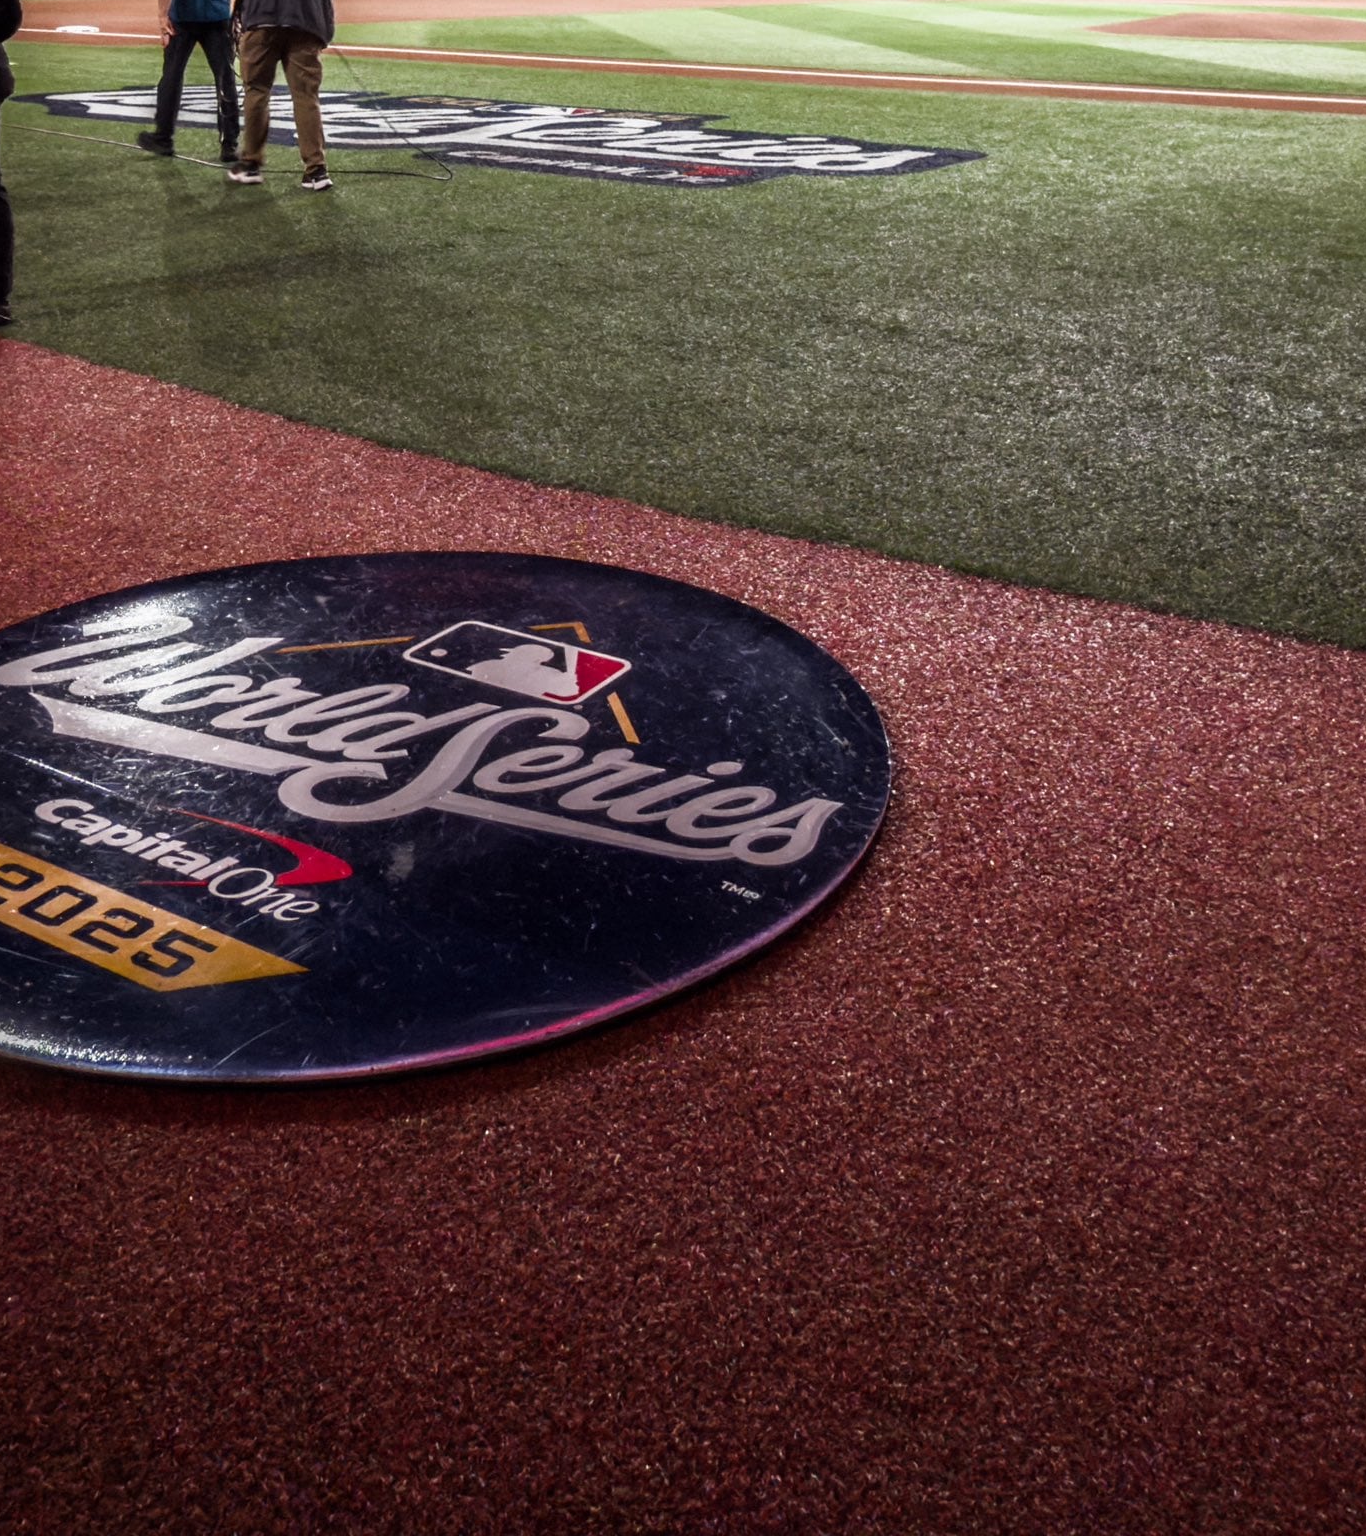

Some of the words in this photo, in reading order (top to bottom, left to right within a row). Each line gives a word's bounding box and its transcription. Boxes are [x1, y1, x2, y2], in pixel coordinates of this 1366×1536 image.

[278, 707, 844, 865] Series
[34, 797, 239, 881] Capital
[206, 866, 321, 922] One
